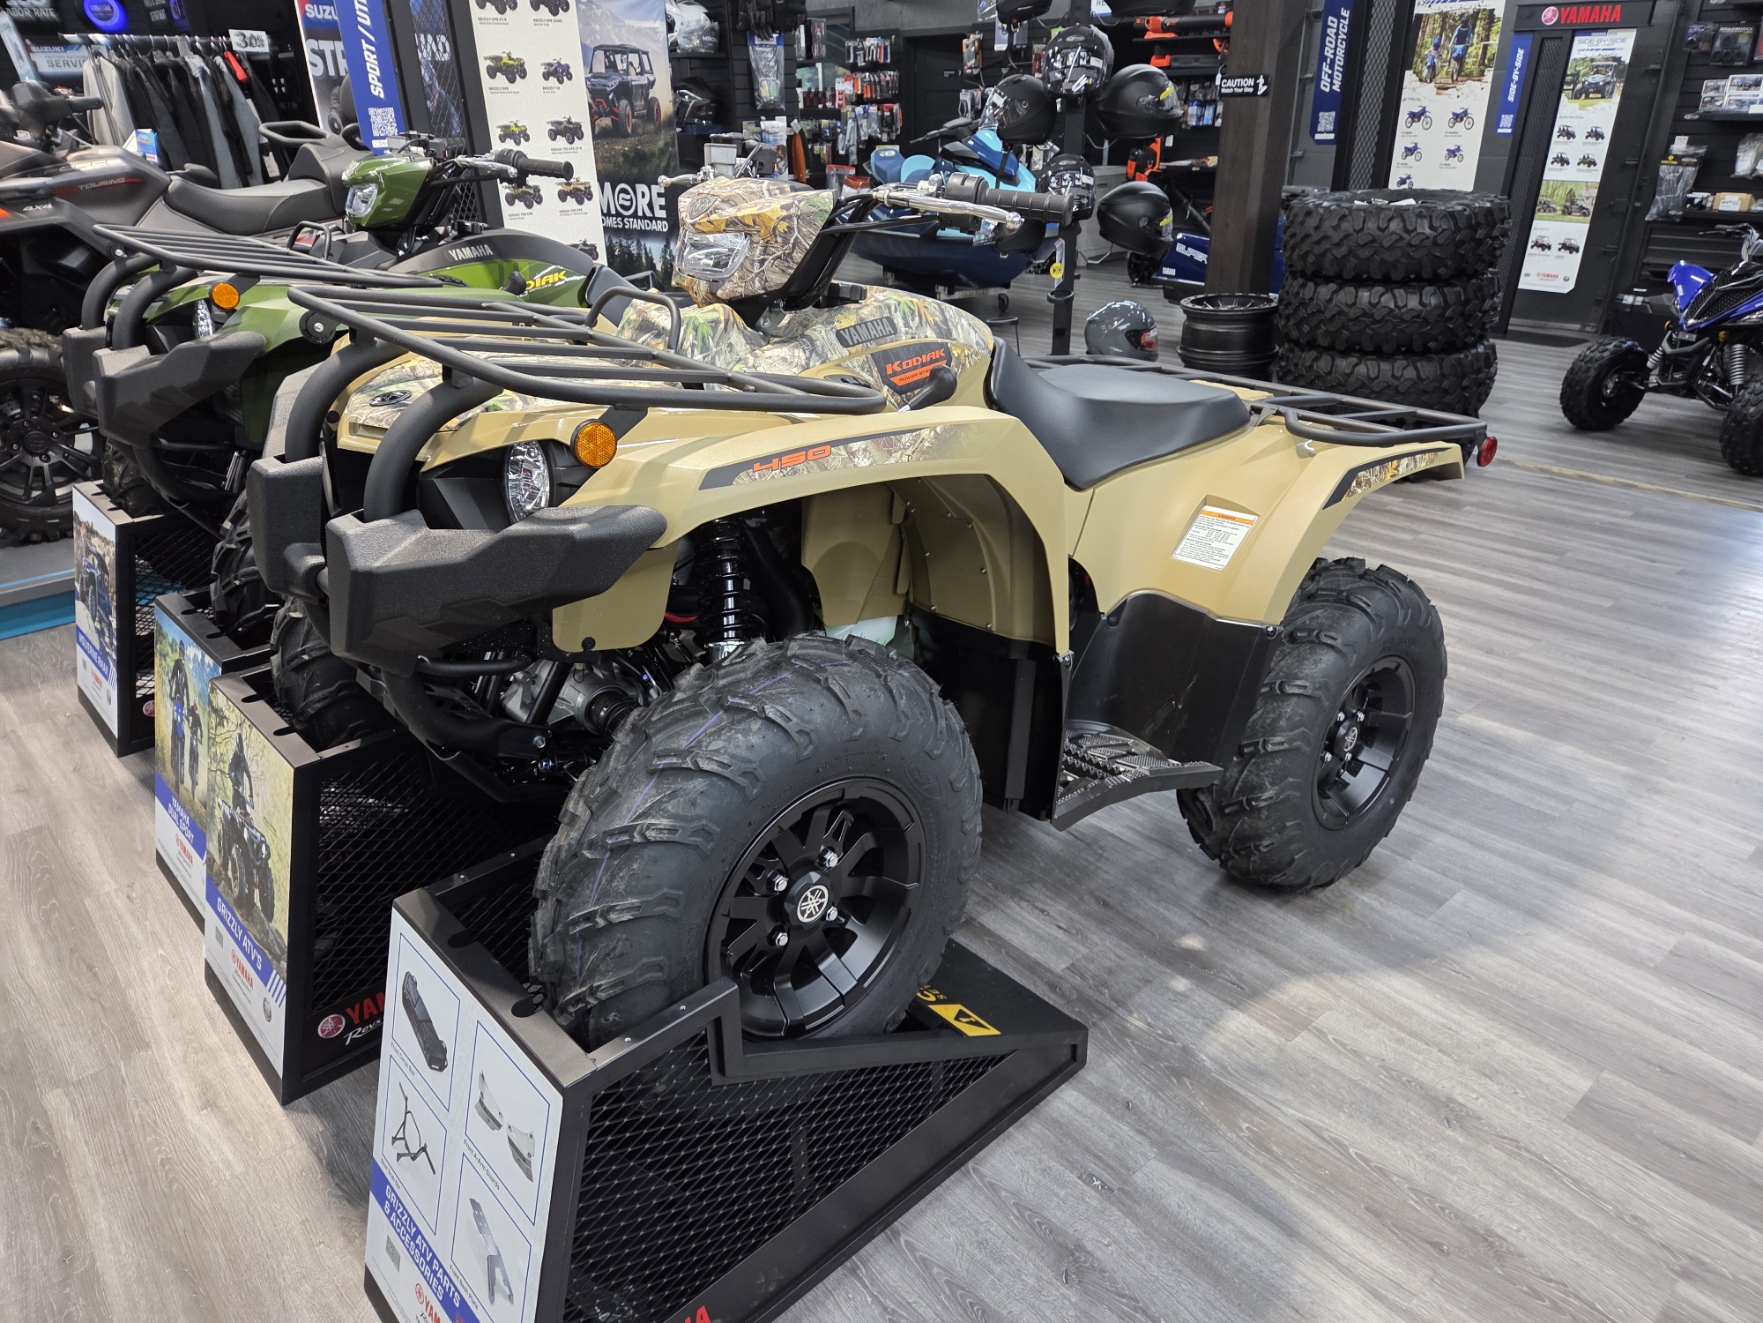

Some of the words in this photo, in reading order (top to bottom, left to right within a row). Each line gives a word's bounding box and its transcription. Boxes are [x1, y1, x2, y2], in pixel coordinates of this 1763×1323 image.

[5, 7, 32, 17] ABOR
[33, 7, 56, 17] RATE
[1560, 5, 1621, 24] YAMAHA
[1320, 16, 1338, 92] OFF-ROAD
[1332, 7, 1350, 92] MOTORCYCLE
[1577, 37, 1627, 45] SIDE-BY-SIDE
[362, 39, 385, 99] SPORT
[1507, 48, 1525, 102] SIDE-BY-SIDE
[1221, 78, 1255, 88] CAUTION
[598, 182, 667, 218] MORE
[601, 215, 623, 229] OMES
[624, 217, 669, 232] STANDARD
[448, 244, 493, 261] YAMAHA
[525, 270, 566, 291] DIAK
[840, 318, 894, 346] YAMAHA
[885, 348, 946, 375] KODIAK
[753, 445, 832, 472] 450
[179, 818, 195, 845] SPORT
[217, 897, 243, 942] GRIZZLY
[242, 934, 263, 971] ATV'S
[235, 958, 254, 991] YAMAHA
[463, 1137, 474, 1157] Front
[383, 1199, 391, 1217] &
[389, 1209, 445, 1302] ACCESSORIES
[385, 1183, 416, 1238] GRIZZLY
[415, 1230, 432, 1266] ATV
[432, 1258, 461, 1309] PARTS
